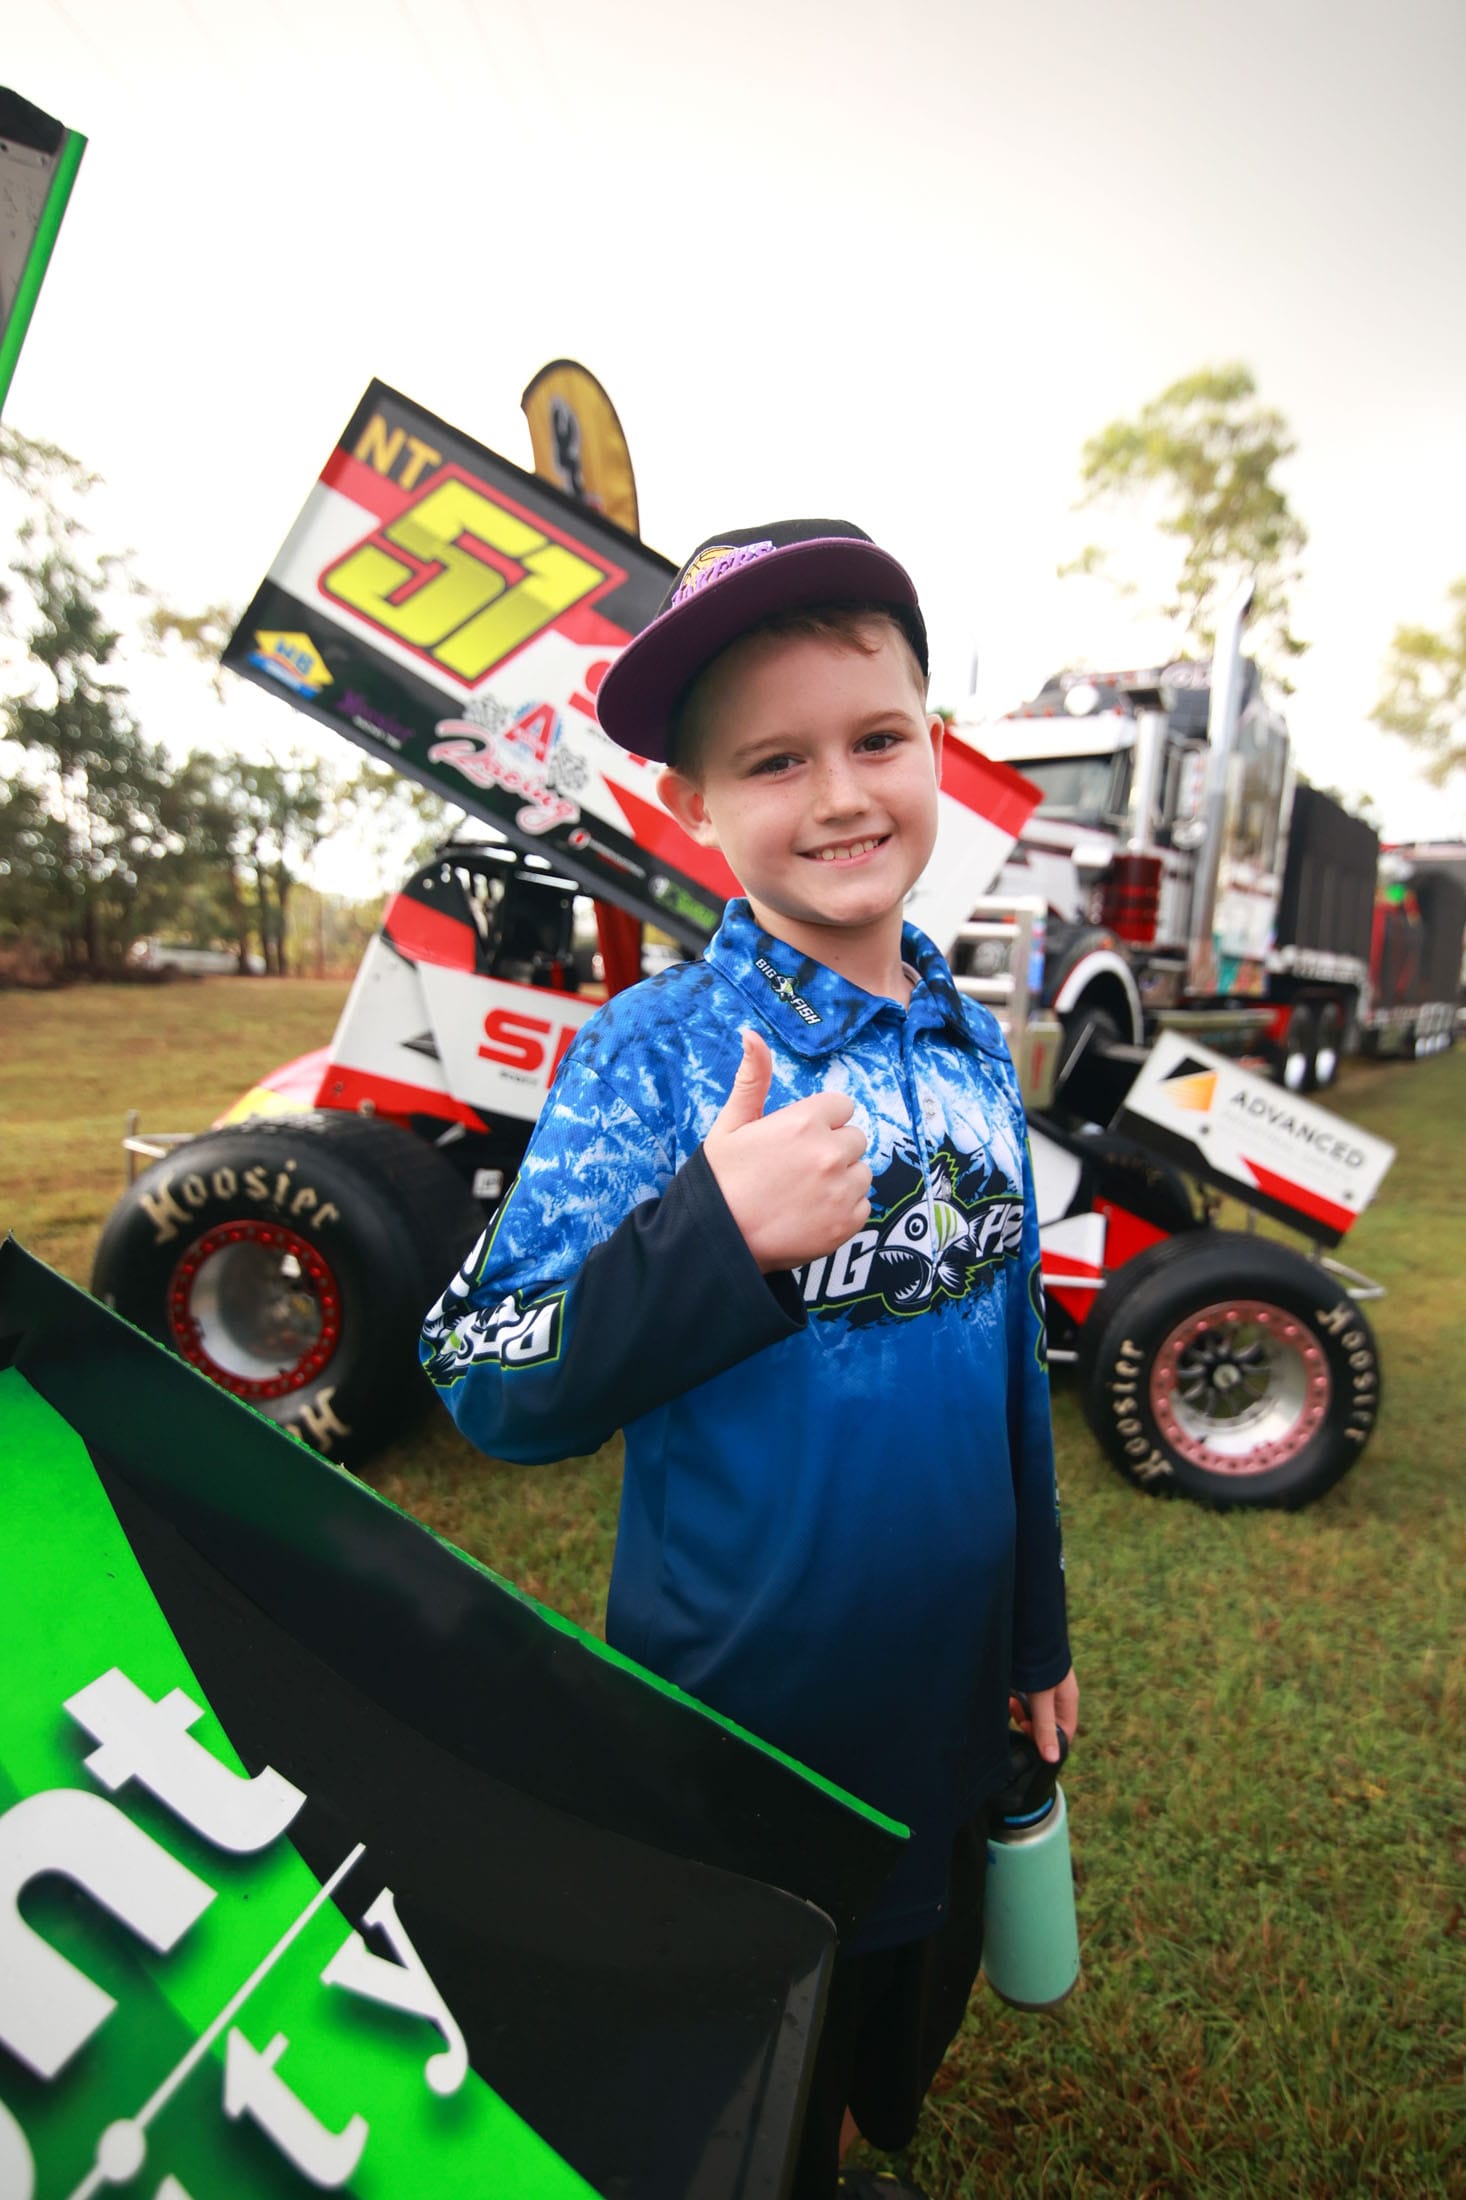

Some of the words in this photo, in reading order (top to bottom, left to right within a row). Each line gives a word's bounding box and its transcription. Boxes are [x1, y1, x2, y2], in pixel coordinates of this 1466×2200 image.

[352, 413, 441, 492] NT
[323, 476, 606, 682] 51
[427, 718, 581, 835] Racing
[755, 958, 777, 979] BIG
[790, 998, 821, 1025] FISH
[1228, 1088, 1367, 1168] ADVANCED
[138, 1158, 341, 1244] Hoosier
[791, 1229, 880, 1302] IG
[1107, 1338, 1175, 1482] Hoosier
[1315, 1302, 1377, 1442] Hoosier
[0, 1666, 308, 2200] nt
[155, 1886, 469, 2200] ty
